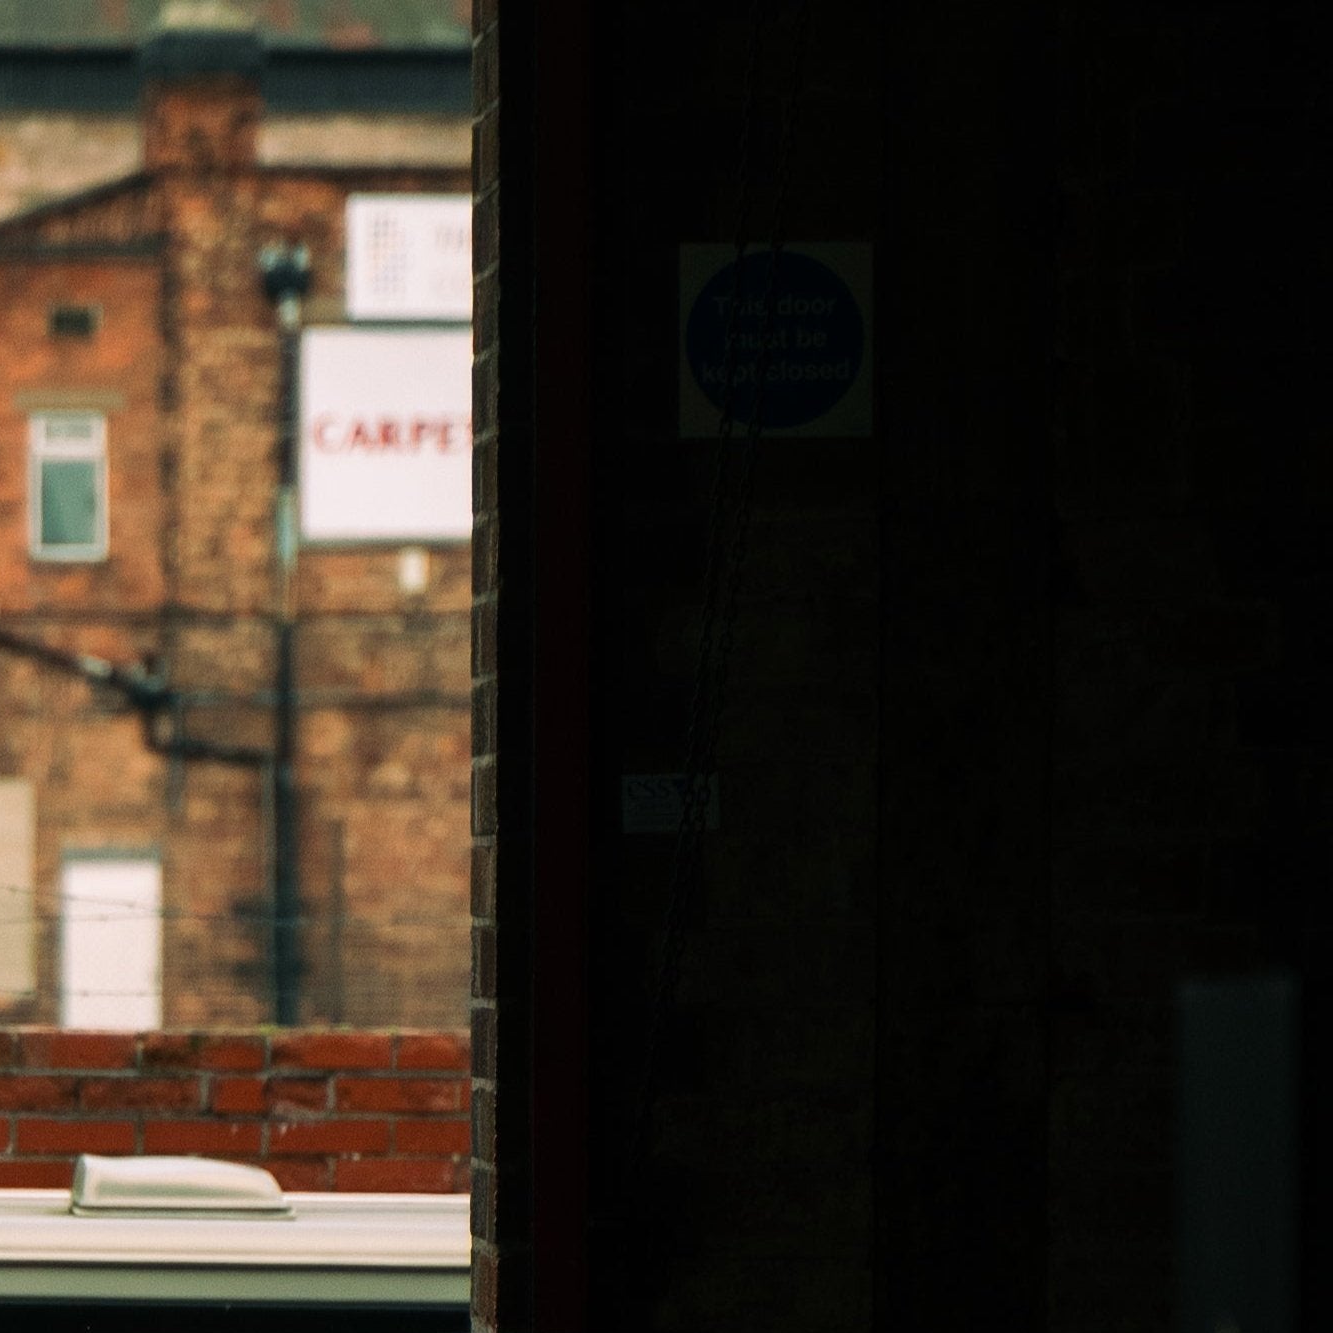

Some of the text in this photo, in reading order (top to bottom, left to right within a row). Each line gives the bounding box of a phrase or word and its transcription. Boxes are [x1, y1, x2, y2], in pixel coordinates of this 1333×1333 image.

[776, 294, 837, 316] door
[794, 325, 828, 347] be
[314, 415, 472, 454] CARPE
